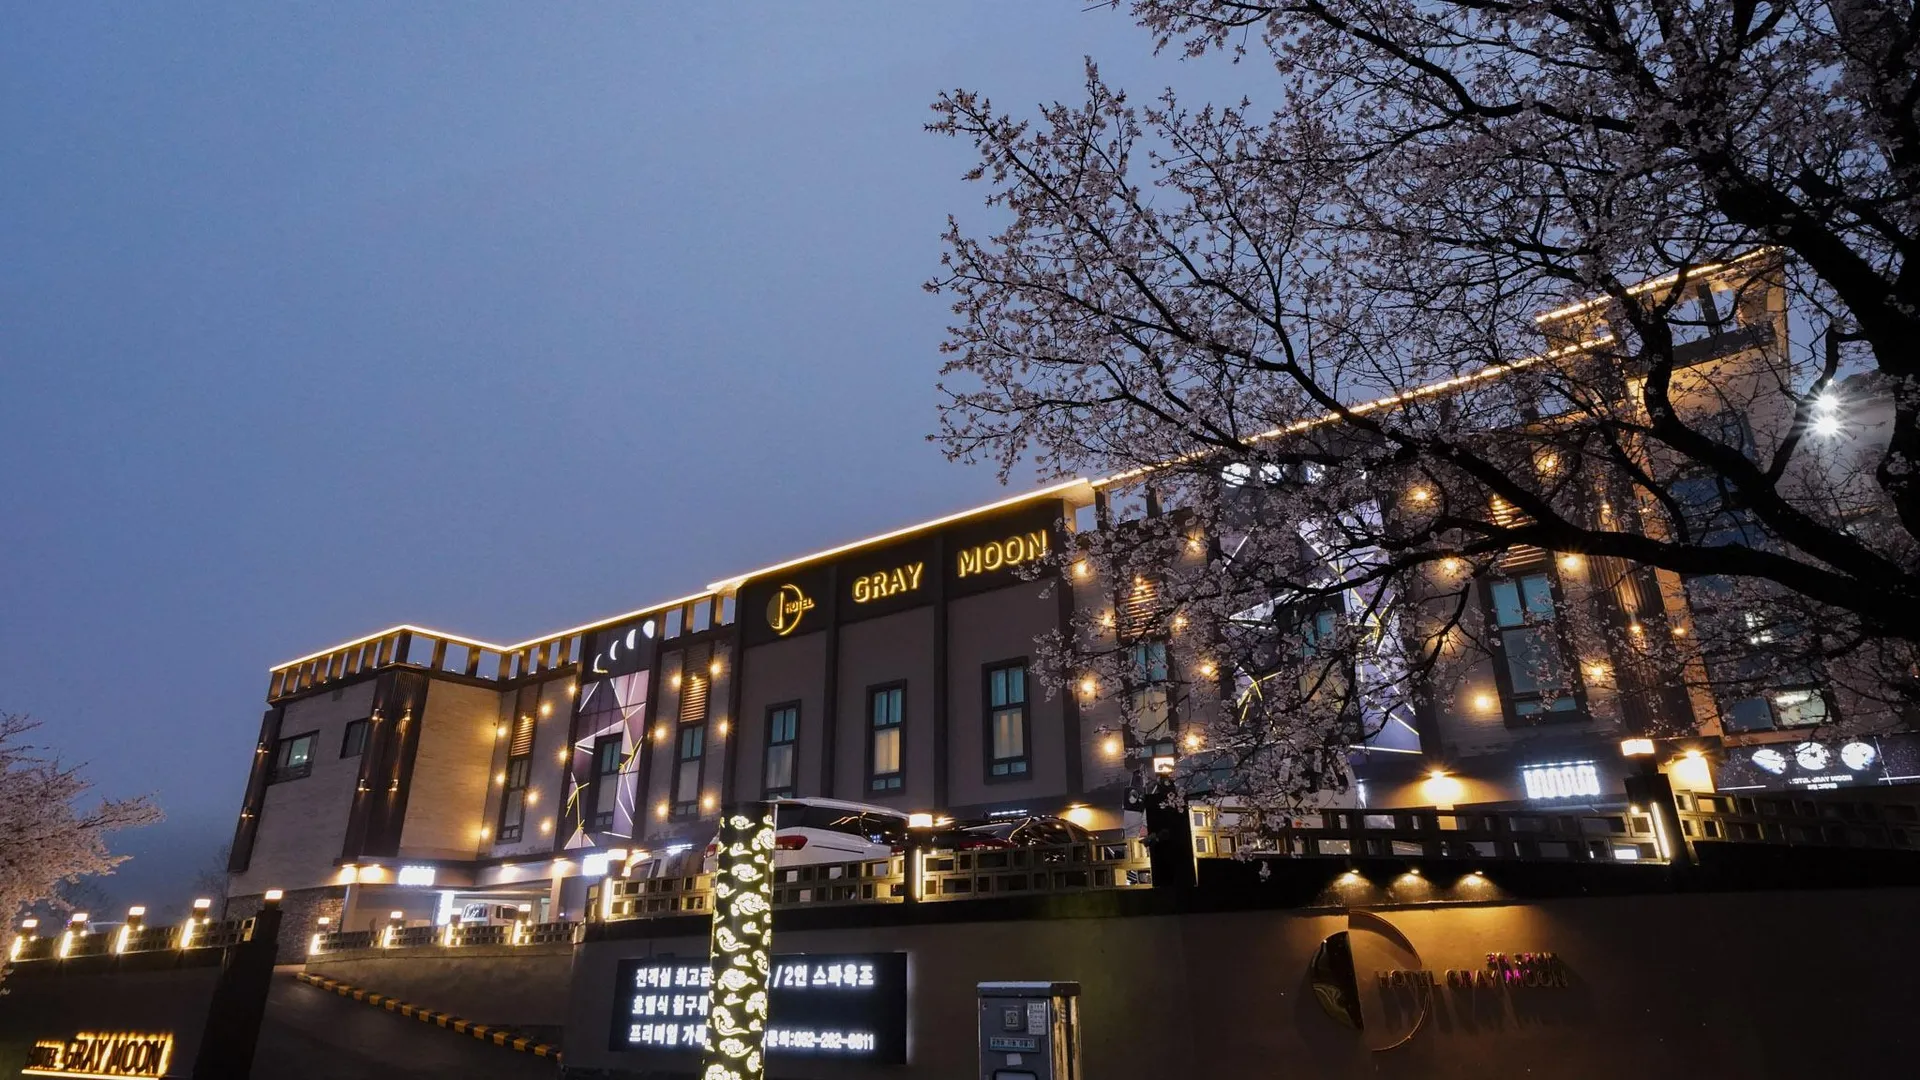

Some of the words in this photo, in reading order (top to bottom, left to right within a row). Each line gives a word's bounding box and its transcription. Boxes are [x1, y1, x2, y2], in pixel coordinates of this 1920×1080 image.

[854, 562, 923, 603] GRAY
[957, 529, 1048, 577] MOON
[786, 598, 814, 614] HOTEL
[636, 967, 671, 988] 전객실
[812, 964, 874, 987] 스파욕조
[1375, 969, 1442, 988] HOTEL
[1445, 969, 1498, 988] GRAY
[632, 995, 669, 1016] 호텔식
[629, 1023, 678, 1045] 프리미엄
[63, 1036, 112, 1072] GRAY
[105, 1037, 167, 1076] MOON
